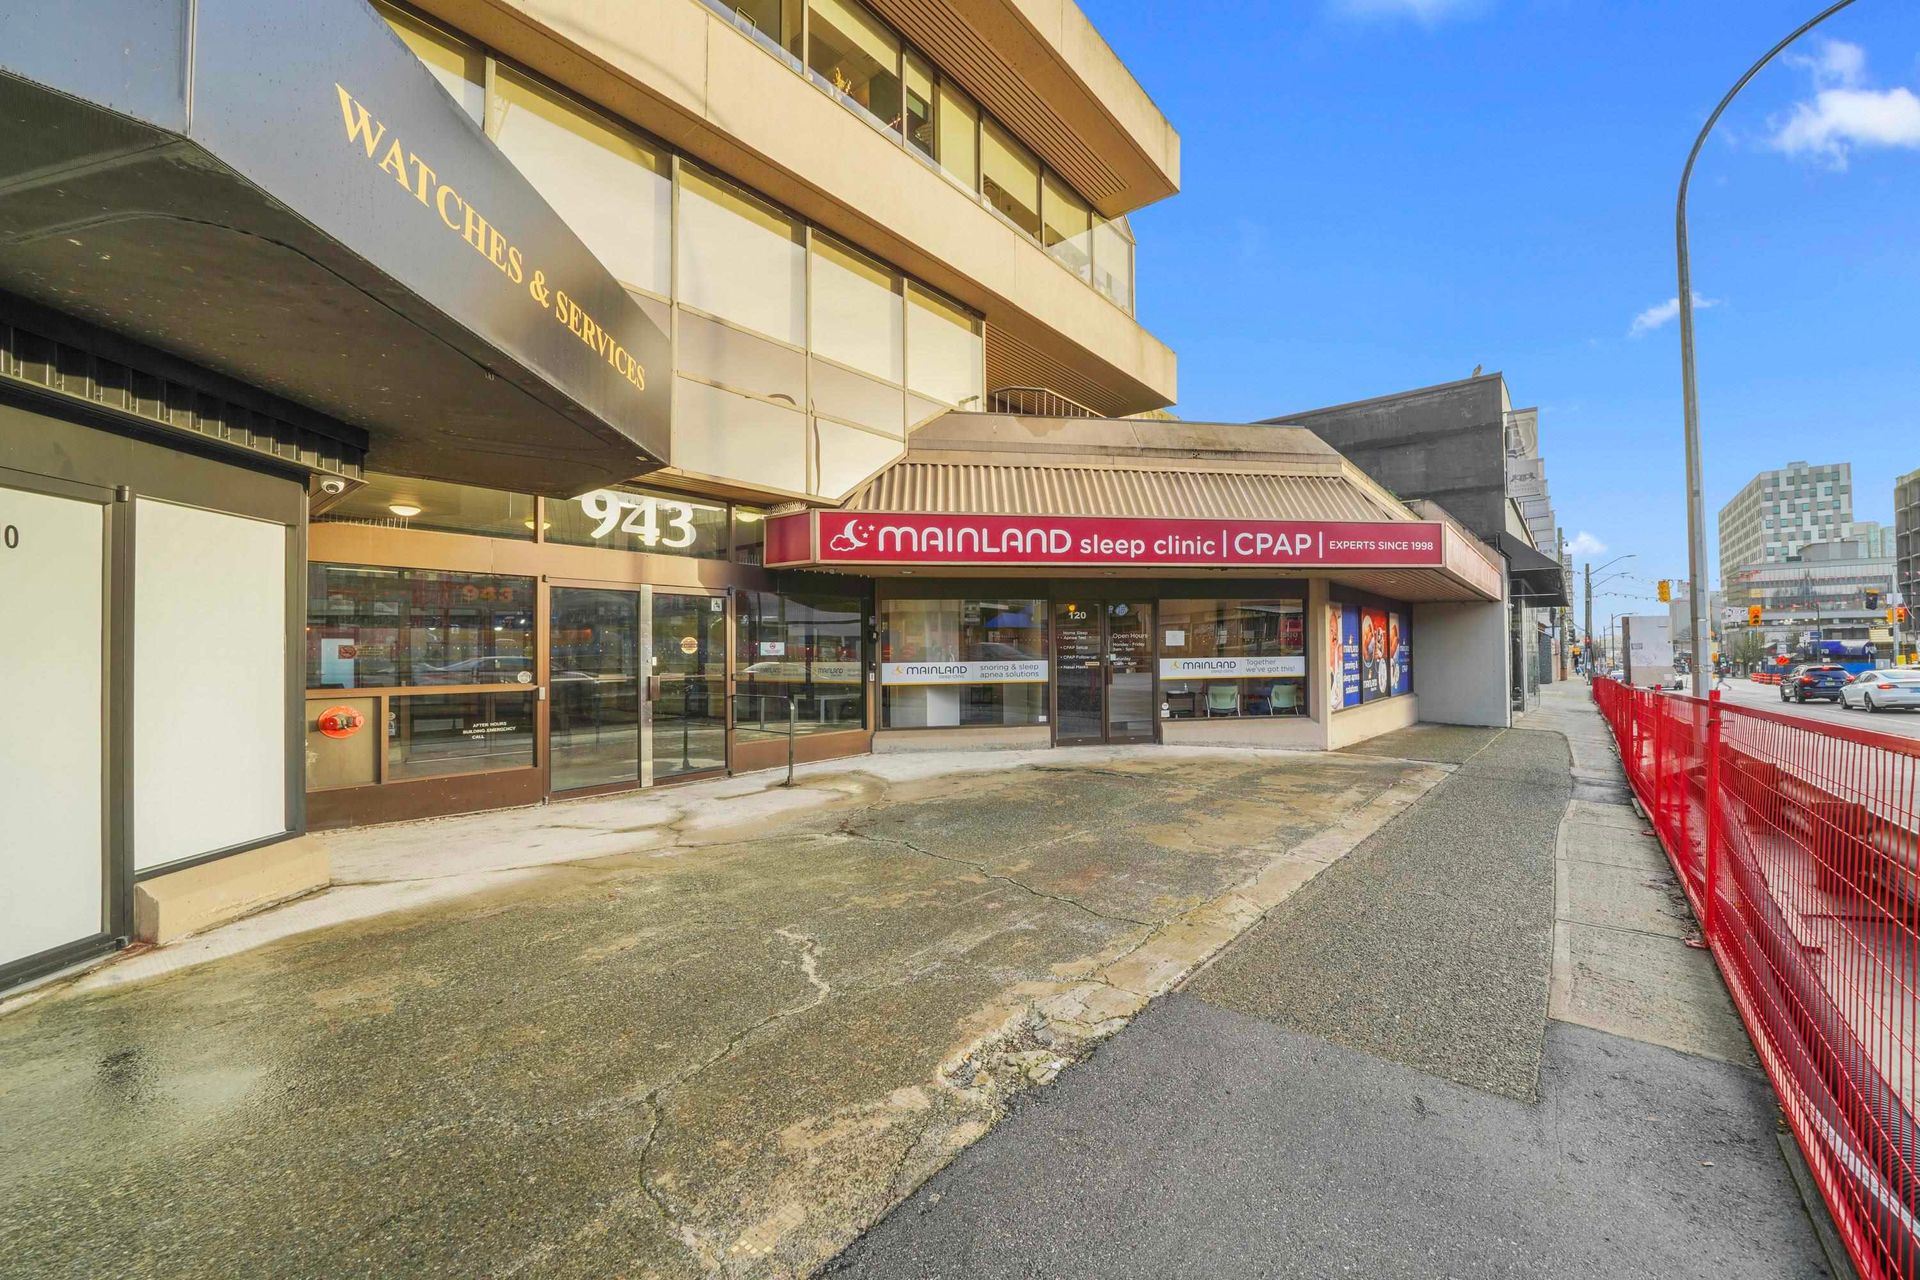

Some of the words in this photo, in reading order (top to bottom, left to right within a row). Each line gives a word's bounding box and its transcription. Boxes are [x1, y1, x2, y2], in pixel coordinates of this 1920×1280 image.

[335, 82, 523, 284] WATCHES
[529, 270, 550, 308] &
[555, 290, 646, 391] SERVICES
[581, 488, 697, 548] 943
[879, 525, 1072, 554] MAINLAND
[1080, 534, 1146, 558] sleep
[1153, 535, 1216, 556] clinic
[1234, 532, 1312, 556] CPAP
[1329, 540, 1376, 551] EXPERTS
[1377, 540, 1409, 551] SINCE
[1411, 541, 1434, 551] 1998
[1068, 611, 1087, 620] 120
[1183, 661, 1236, 669] MAINLAND
[1246, 659, 1276, 667] Together
[906, 665, 968, 675] MAINLAND
[1019, 664, 1039, 672] sleep
